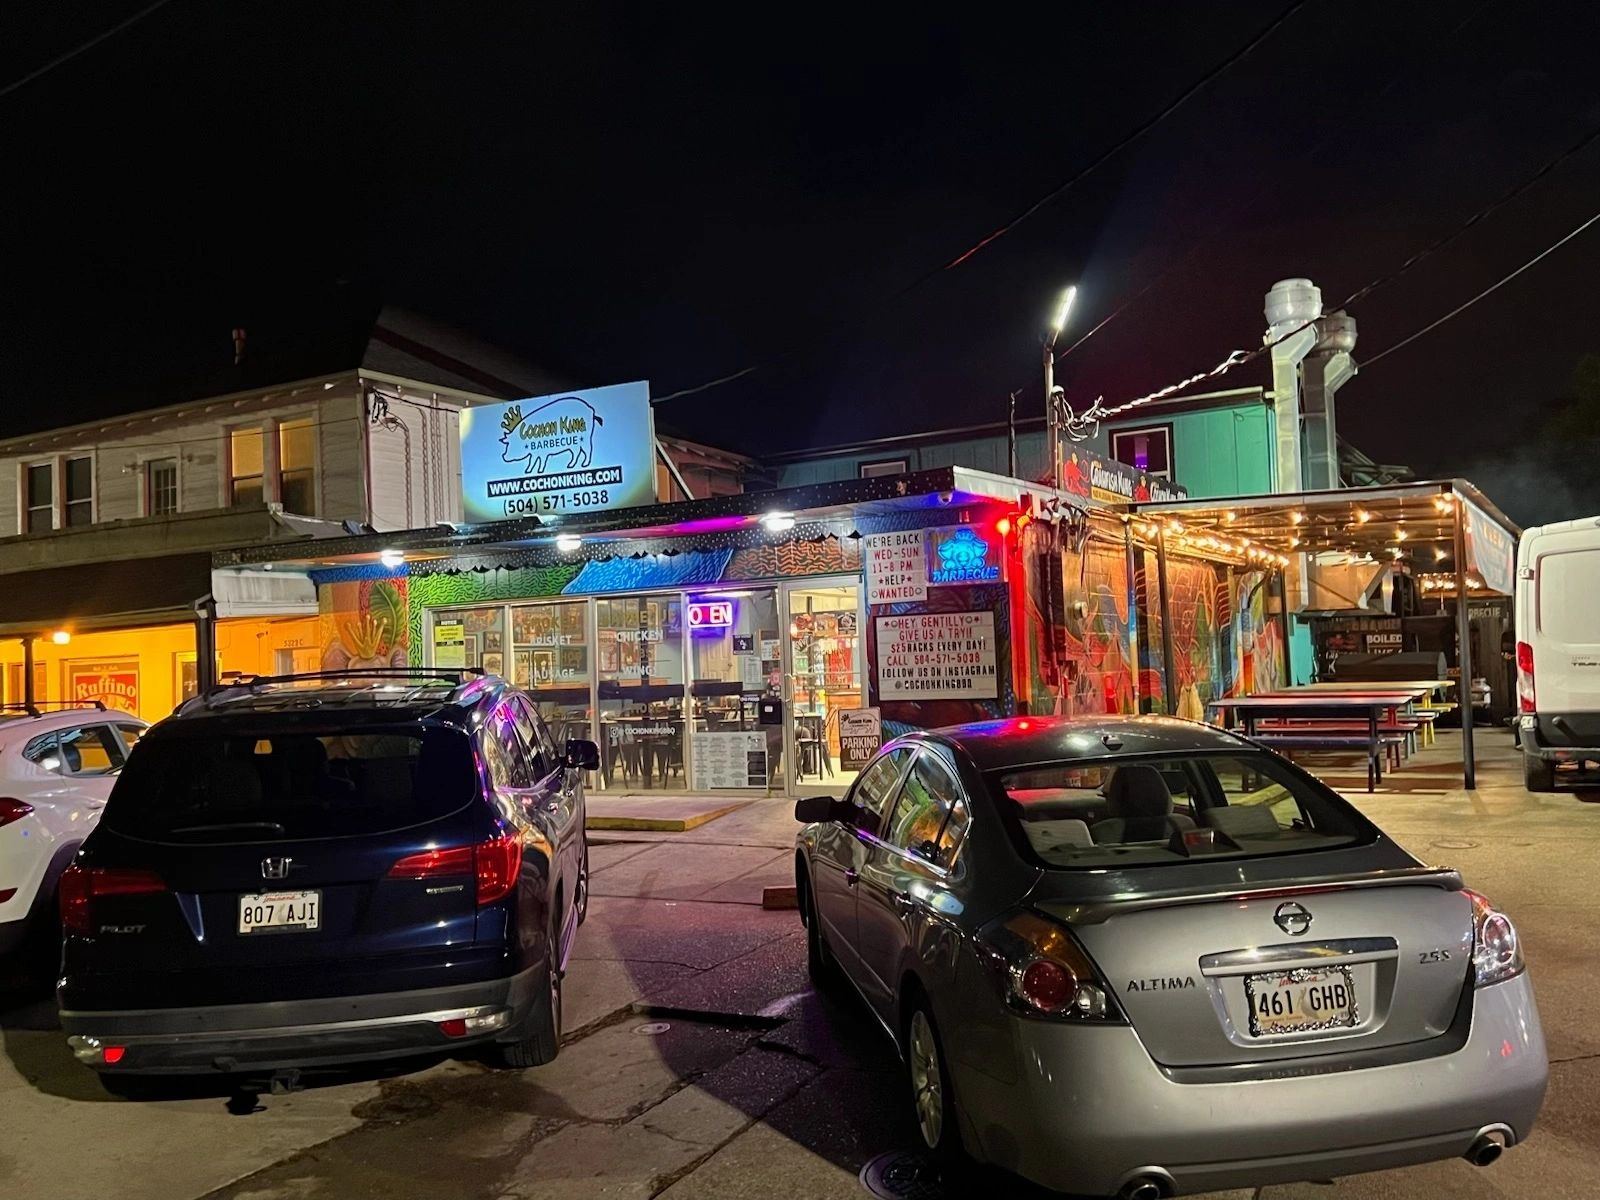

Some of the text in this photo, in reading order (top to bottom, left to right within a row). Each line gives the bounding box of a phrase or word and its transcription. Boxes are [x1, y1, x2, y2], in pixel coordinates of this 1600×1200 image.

[530, 436, 578, 450] BARBECUE
[489, 469, 620, 496] WWW.COCHONKING.COM
[503, 490, 609, 516] (504) 571-5038
[866, 533, 920, 548] WE'RE BACK
[900, 560, 913, 571] PM
[885, 574, 906, 586] HELP
[932, 565, 999, 582] BARBECUE
[878, 585, 915, 599] WANTED
[690, 605, 731, 625] OEN
[921, 615, 964, 628] GENTILLY
[616, 629, 664, 642] CHICKEN
[899, 629, 919, 641] GIVE
[922, 629, 935, 640] US
[937, 629, 943, 639] A
[1366, 634, 1402, 643] BOILED
[886, 656, 908, 666] CALL
[882, 668, 914, 679] FOLLOW
[917, 668, 928, 677] US
[944, 665, 995, 677] INSTAGRAM
[76, 677, 137, 698] Ruffino
[841, 736, 879, 750] PARKING
[850, 748, 871, 760] ONLY
[243, 902, 316, 925] 807 AJI
[1126, 976, 1196, 993] ALTIMA
[1259, 984, 1348, 1017] 461 GHB
